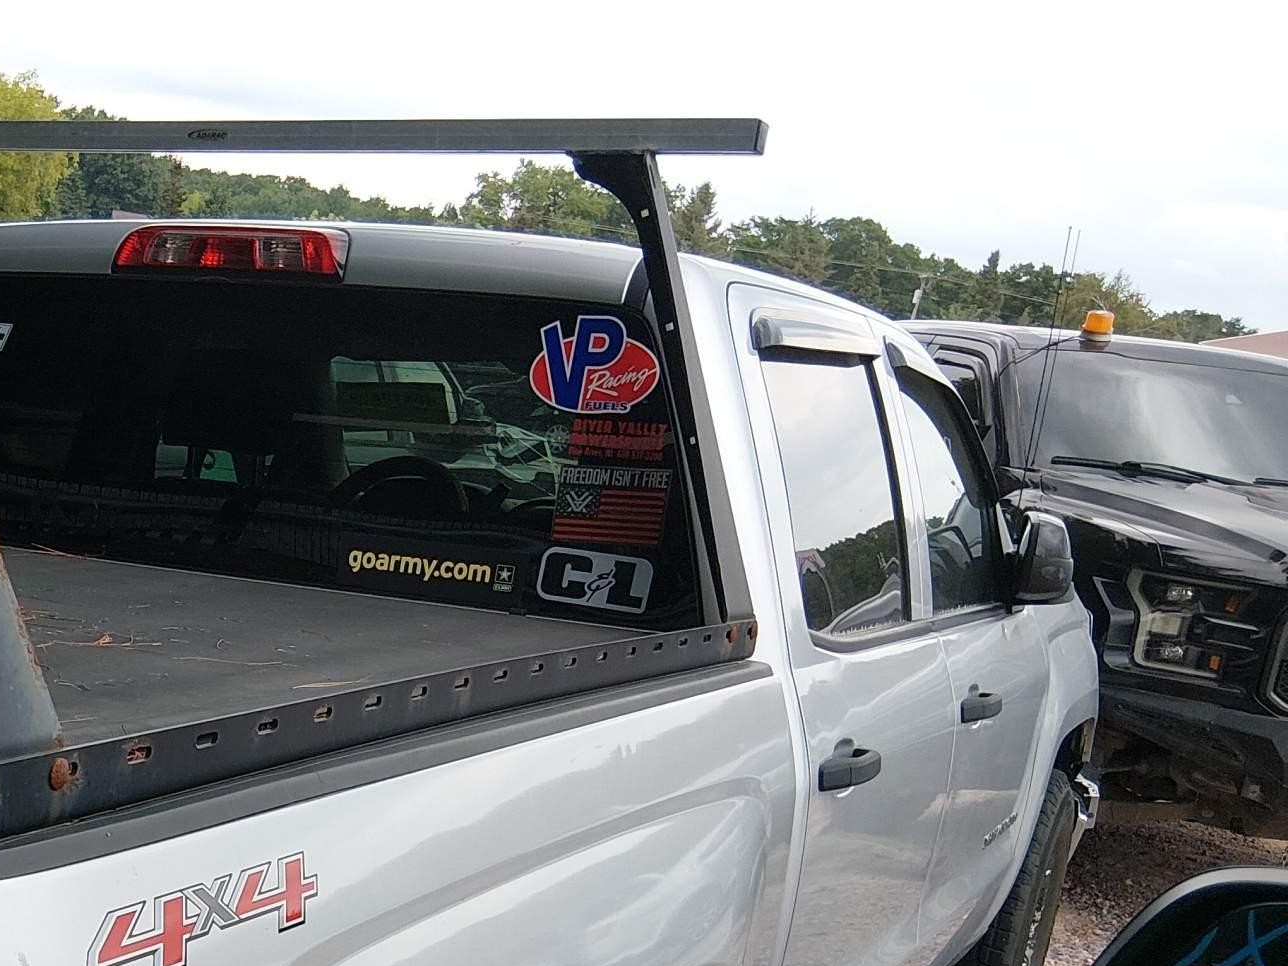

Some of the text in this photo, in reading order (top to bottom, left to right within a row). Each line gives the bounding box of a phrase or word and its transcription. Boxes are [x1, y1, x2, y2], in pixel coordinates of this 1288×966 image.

[541, 315, 627, 412] VP
[585, 366, 657, 400] Racing
[584, 401, 630, 412] FUELS
[617, 421, 668, 437] VALLEY
[561, 466, 670, 489] FREEDOM ISN'T FREE
[348, 549, 492, 582] goarmy.com
